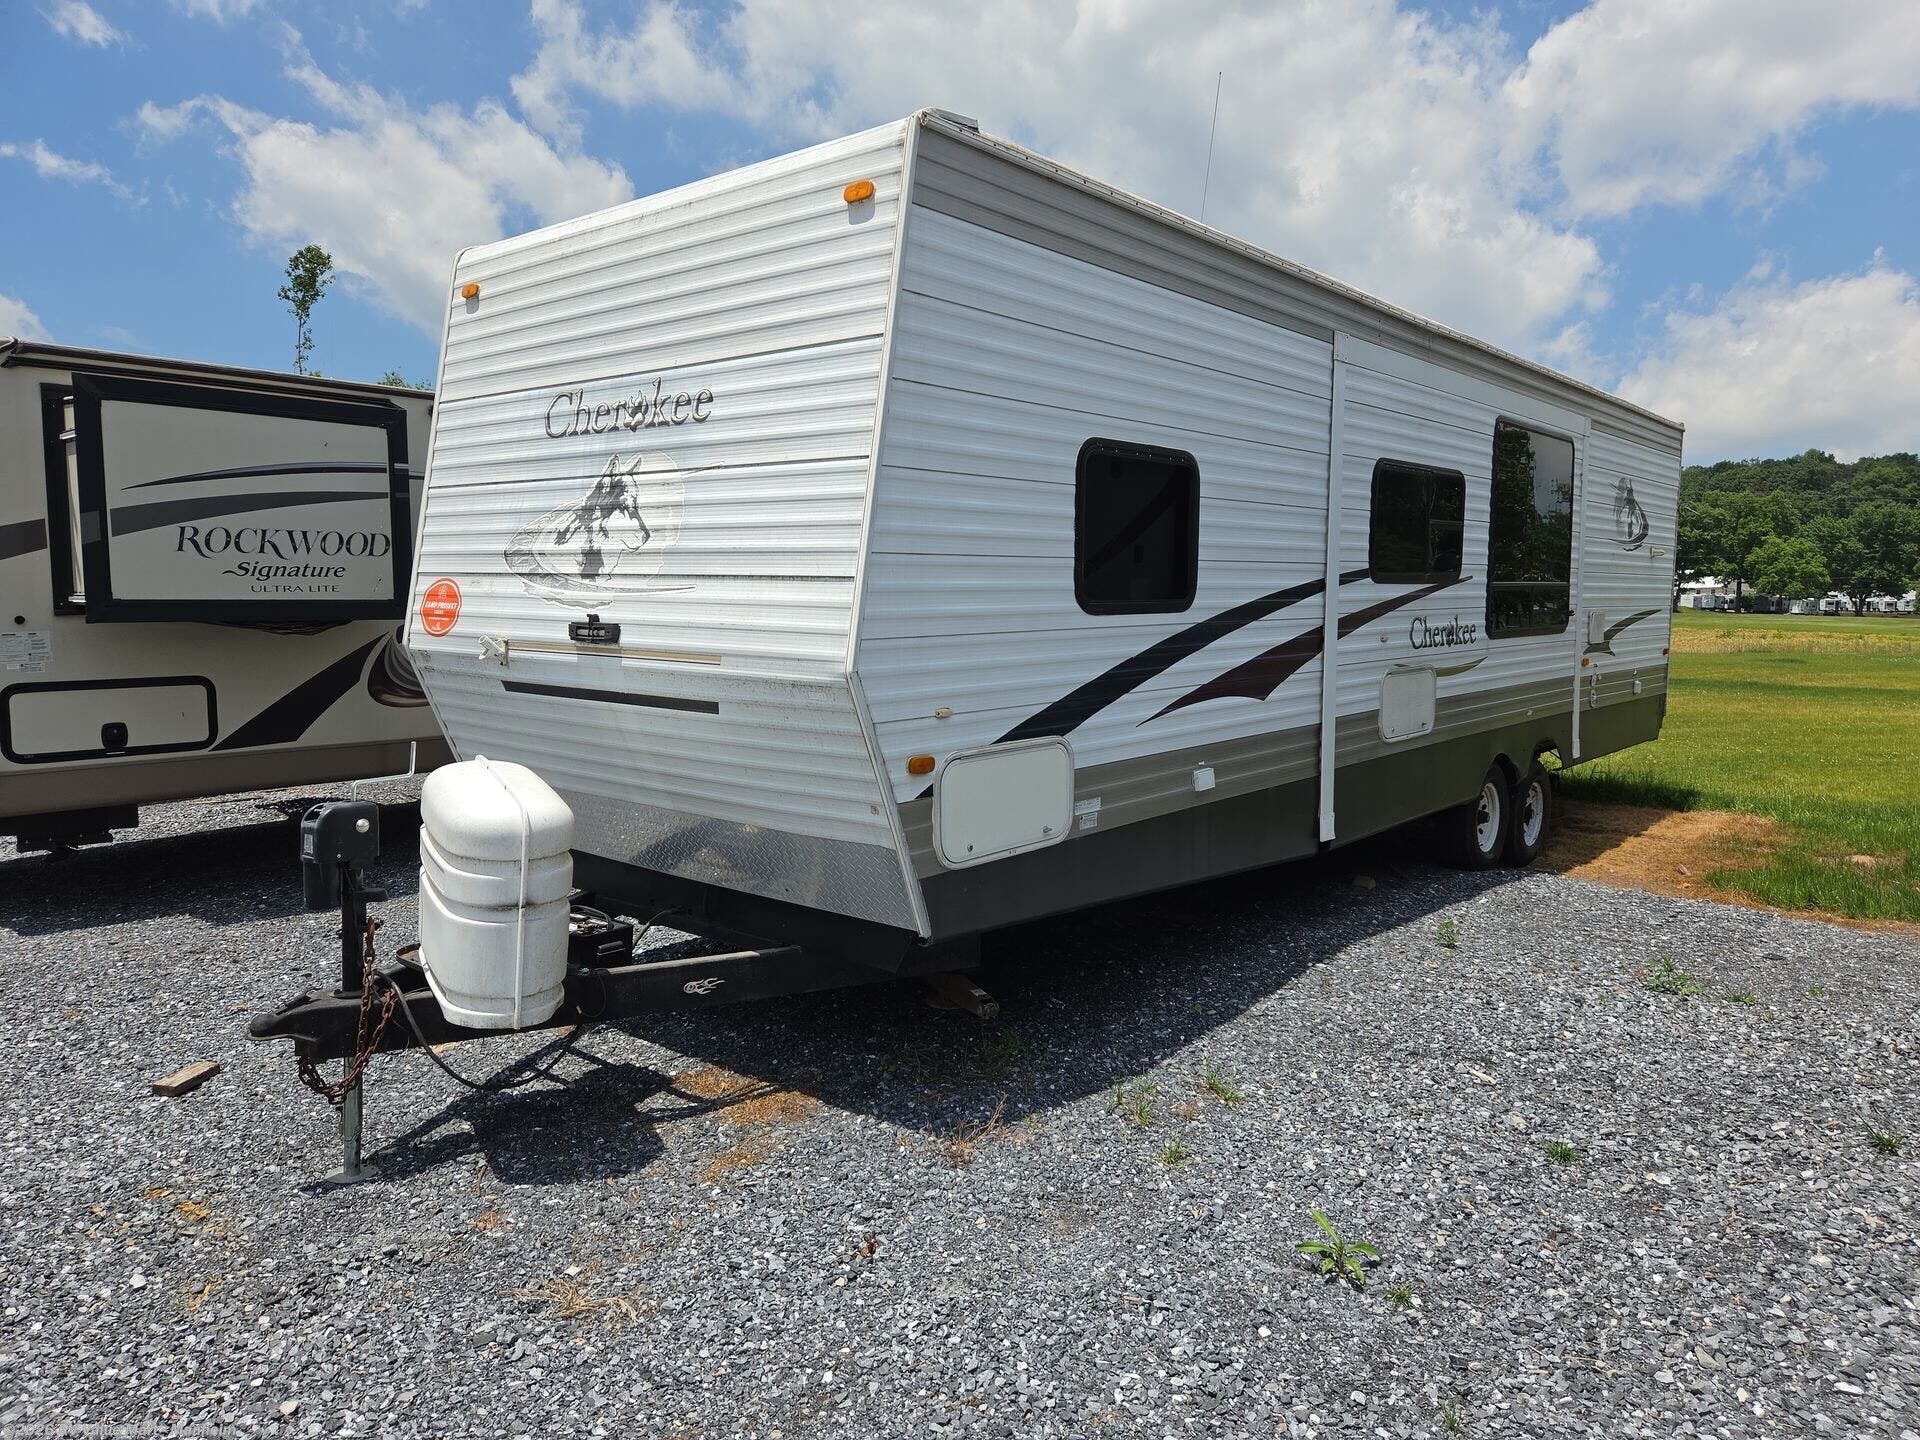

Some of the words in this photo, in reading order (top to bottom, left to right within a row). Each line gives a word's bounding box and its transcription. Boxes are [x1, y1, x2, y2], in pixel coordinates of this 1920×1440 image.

[544, 376, 715, 439] Cherokee
[175, 525, 391, 560] ROCKWOOD
[222, 560, 346, 582] Signature
[251, 584, 304, 593] ULTRA
[308, 584, 341, 593] LITE
[1409, 613, 1477, 650] Cherokee
